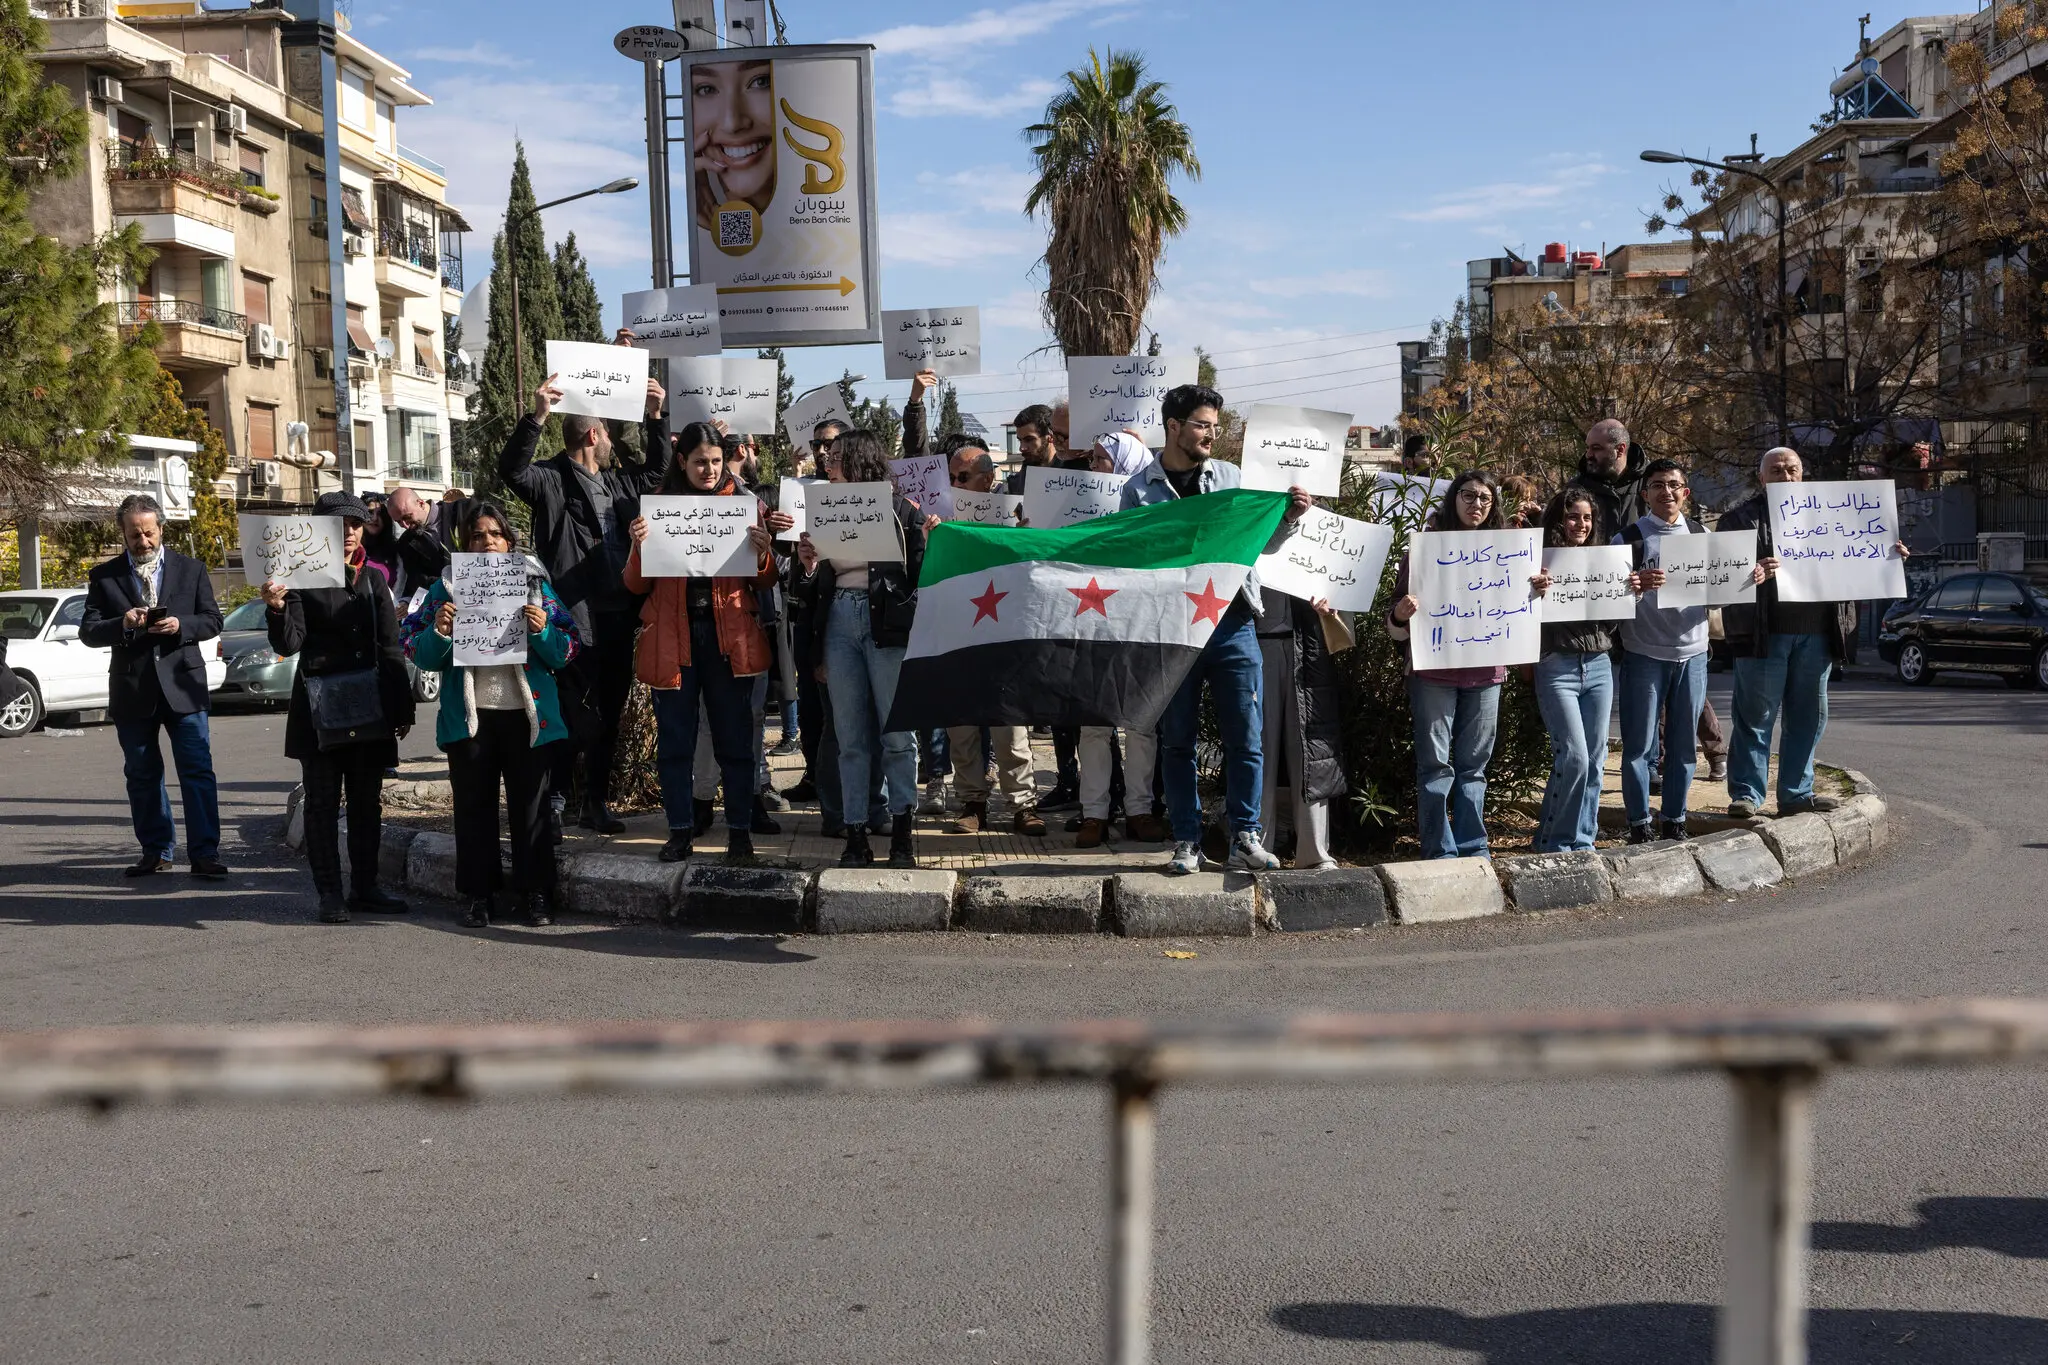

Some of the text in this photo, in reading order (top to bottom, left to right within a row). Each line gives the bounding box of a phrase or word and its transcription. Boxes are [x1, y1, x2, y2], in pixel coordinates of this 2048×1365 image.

[640, 28, 650, 36] 93
[634, 38, 679, 48] PreView
[794, 196, 845, 214] بينوبان
[789, 215, 850, 224] Beno Ban Clinic
[762, 273, 780, 284] عربي
[799, 270, 832, 280] الدكتورة:
[632, 311, 708, 326] أسمع كلامك أصدقك
[899, 317, 963, 332] نقد الحكومة حق
[658, 328, 683, 340] أفعالك
[687, 325, 710, 339] أشوف
[917, 334, 946, 345] وواجب
[935, 349, 956, 358] عادت
[958, 348, 968, 356] ما
[1112, 360, 1166, 377] لا يمكن العبث
[602, 371, 623, 383] تلغوا
[624, 373, 631, 384] لا
[678, 386, 770, 400] تسيير أعمال لا تعسير
[1089, 384, 1123, 398] السوري
[1124, 384, 1155, 398] النضال
[710, 402, 736, 415] أعمال
[1104, 408, 1154, 428] أي استبداد
[1260, 438, 1330, 452] السلطة للشعب مو
[1278, 458, 1310, 470] عالشعب
[918, 480, 926, 492] لا
[1045, 475, 1077, 492] النابلسي
[1076, 479, 1104, 496] الشيخ
[820, 496, 876, 508] مو هيك تصريف
[928, 492, 940, 506] مع
[956, 498, 972, 512] من
[652, 508, 747, 520] الشعب التركي صديق
[1064, 504, 1098, 518] تفسير
[1780, 493, 1881, 521] نطالب بالتزام
[814, 514, 838, 528] تسريح
[1318, 514, 1344, 534] الفن
[1783, 516, 1888, 540] حكومة تصريف
[262, 522, 312, 544] القانون
[665, 524, 734, 538] الدولة العثمانية
[256, 536, 331, 559] أساس التمدن
[1300, 523, 1365, 562] إبداع إنسا
[686, 544, 714, 556] احتلال
[1437, 537, 1532, 566] أسمع كلامك
[1778, 540, 1886, 562] الأعمال بصلاحياتها
[264, 558, 328, 578] منذ حمورابي
[491, 554, 524, 568] تأهيل
[1668, 557, 1749, 573] شهداء أيار ليسوا من
[1288, 551, 1356, 586] وليس هرطقة
[1584, 574, 1604, 585] العابد
[1606, 572, 1614, 584] آل
[1616, 574, 1623, 584] يا
[1686, 572, 1730, 588] فلول النظام
[1590, 592, 1603, 600] من
[1606, 589, 1624, 600] نازك
[1429, 594, 1532, 620] أشوف أفعالك
